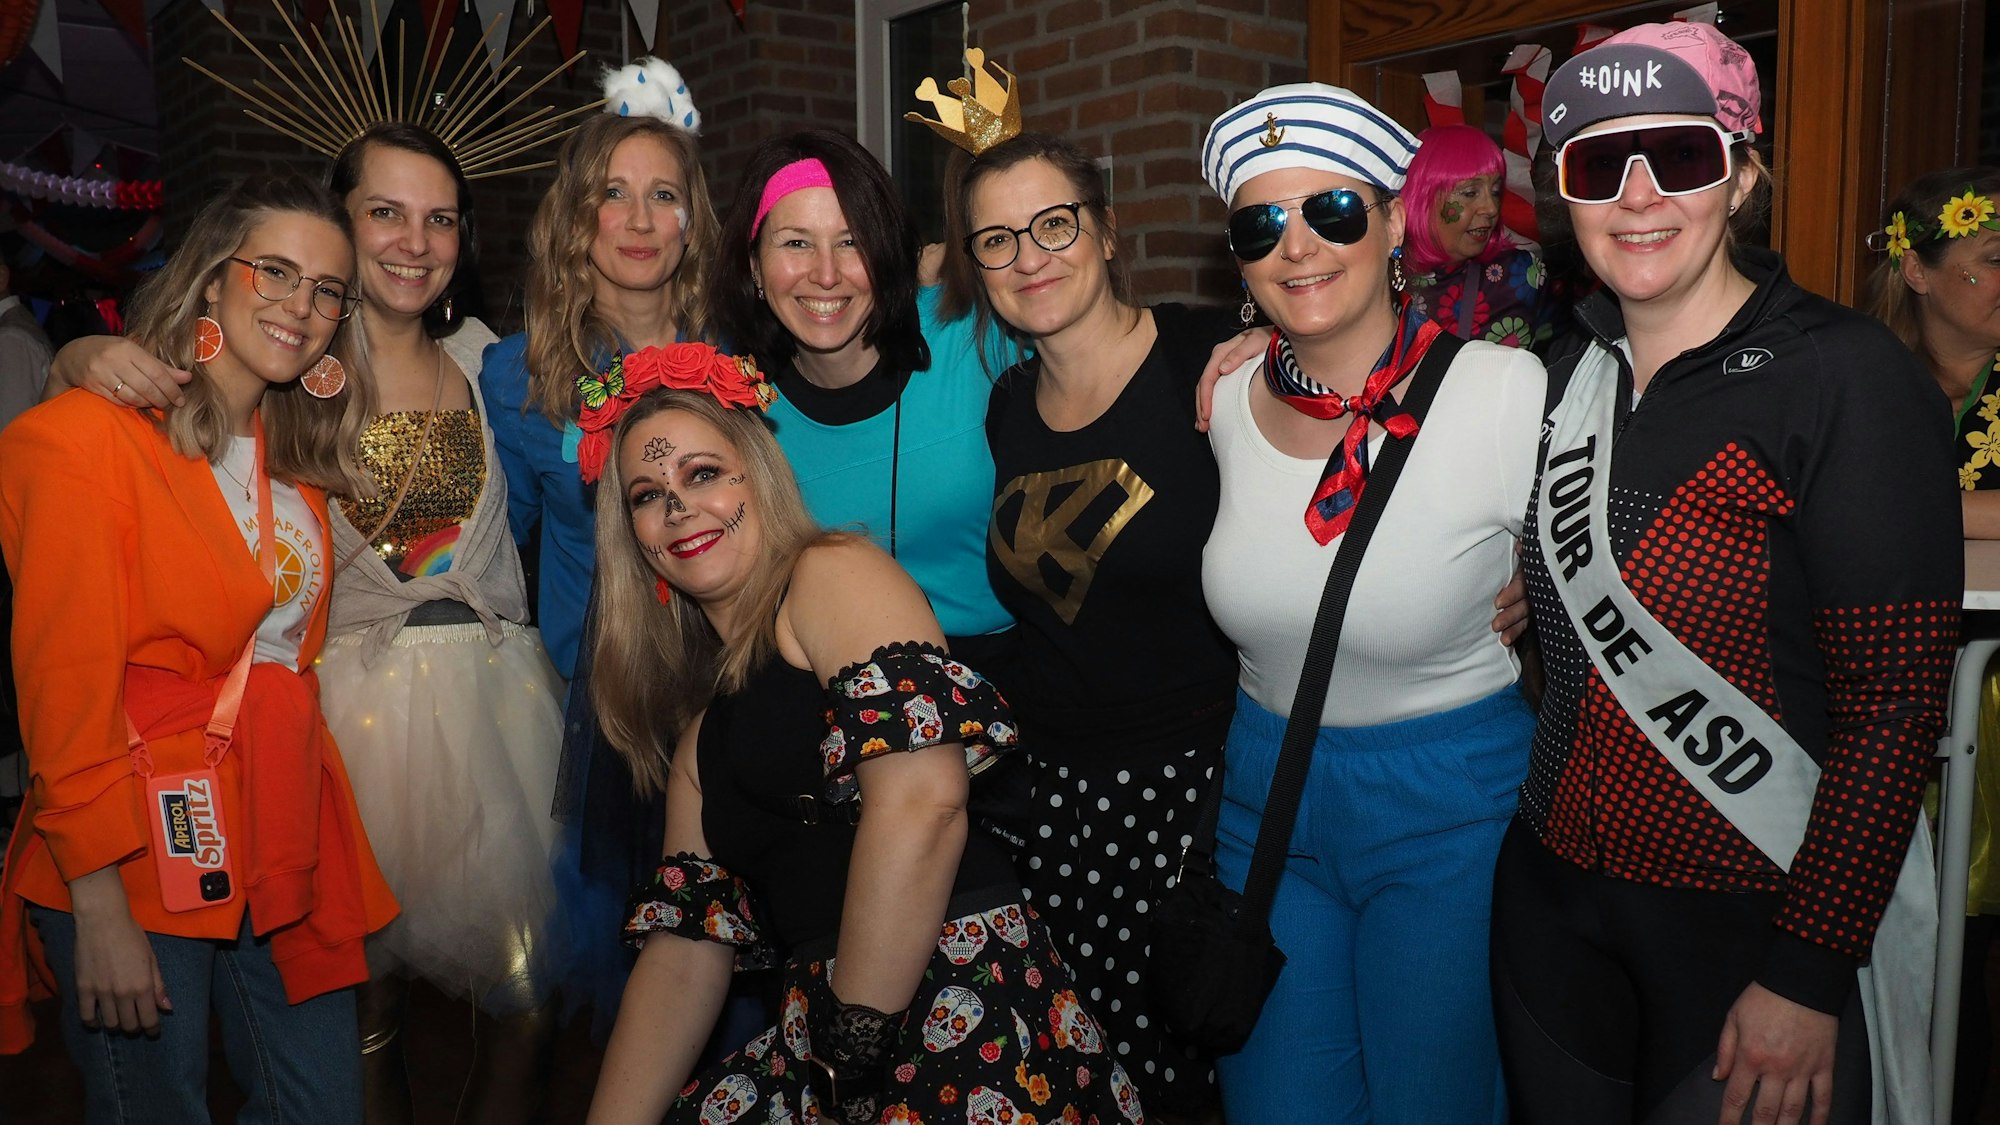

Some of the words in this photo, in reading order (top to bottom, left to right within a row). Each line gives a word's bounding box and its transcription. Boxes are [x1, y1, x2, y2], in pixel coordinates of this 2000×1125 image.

[1548, 434, 1596, 584] TOUR
[1582, 595, 1653, 677] DE
[1645, 688, 1774, 795] ASD
[173, 800, 191, 849] APEROL
[186, 782, 222, 865] Spritz
